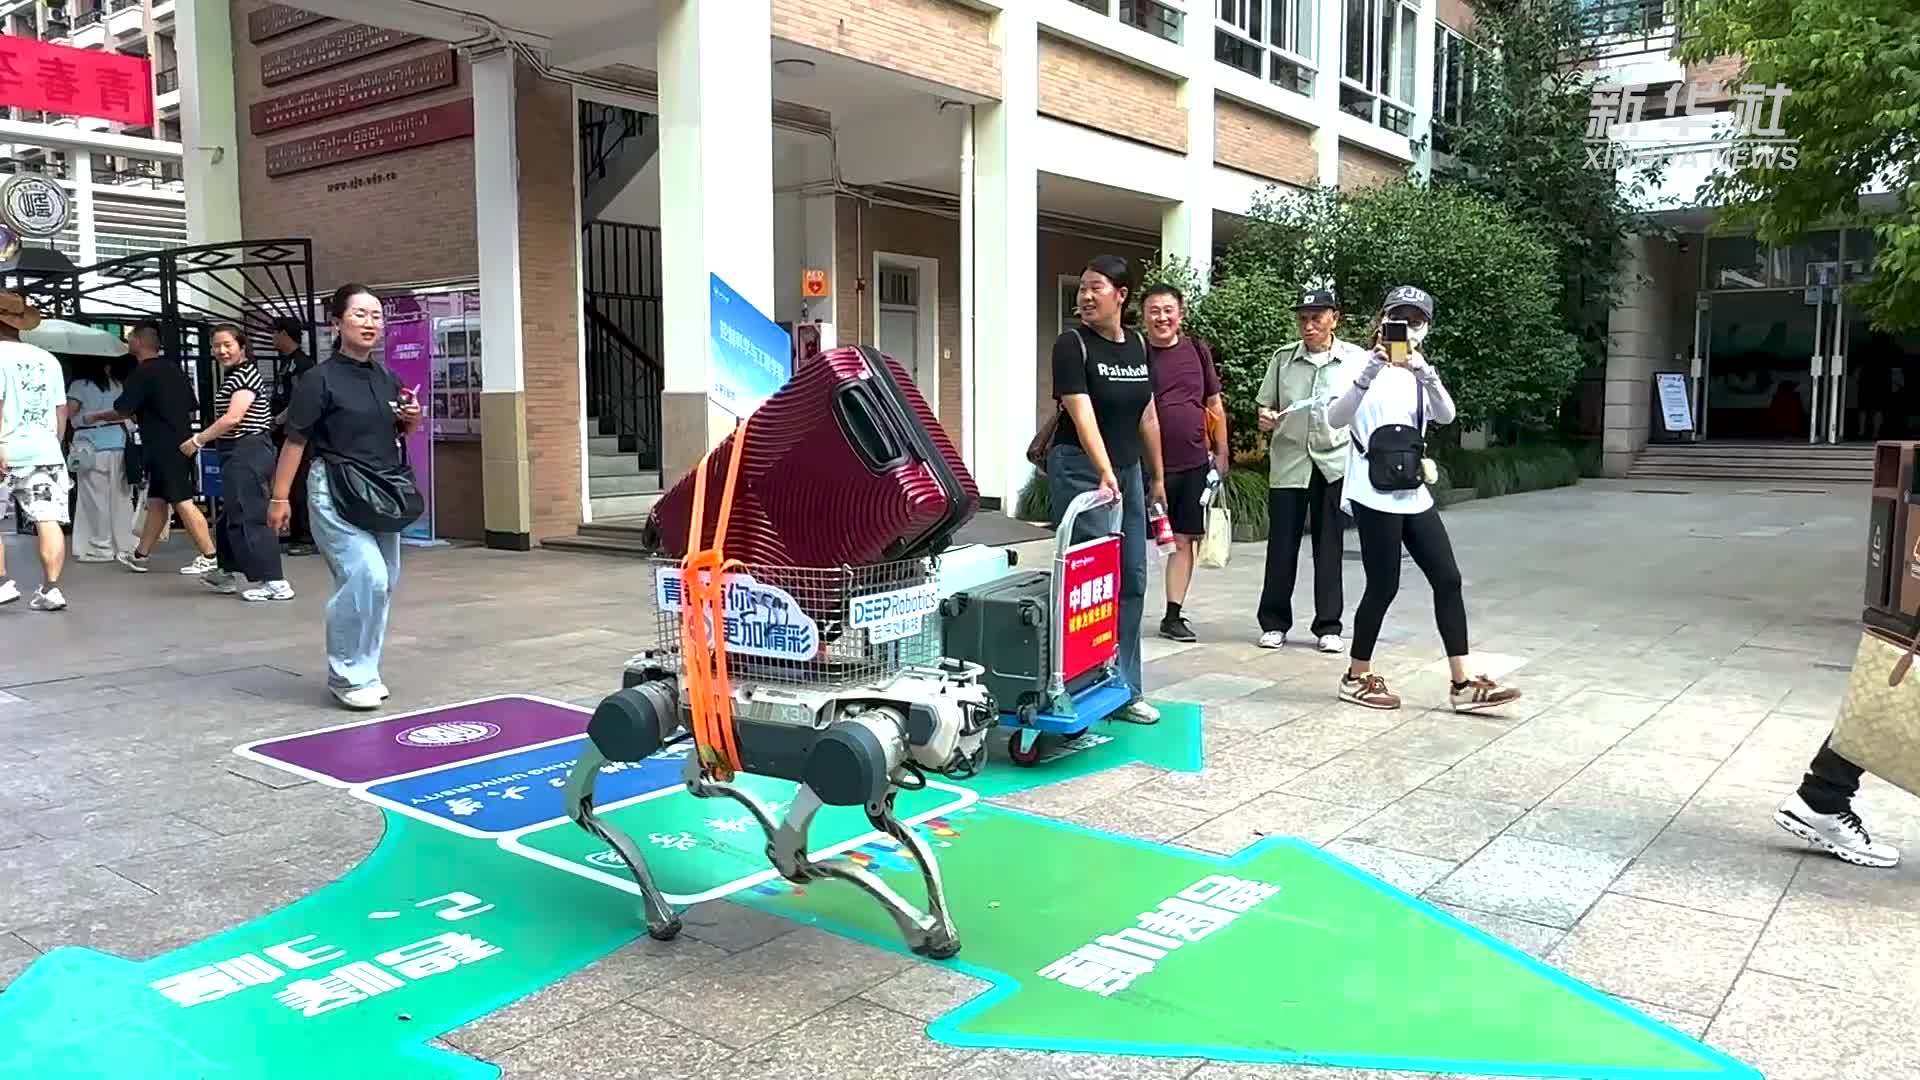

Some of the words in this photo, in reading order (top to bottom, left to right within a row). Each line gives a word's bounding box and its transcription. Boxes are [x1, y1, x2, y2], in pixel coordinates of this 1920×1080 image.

[723, 616, 812, 653] 更加精彩
[411, 770, 524, 804] UNIVERSITY
